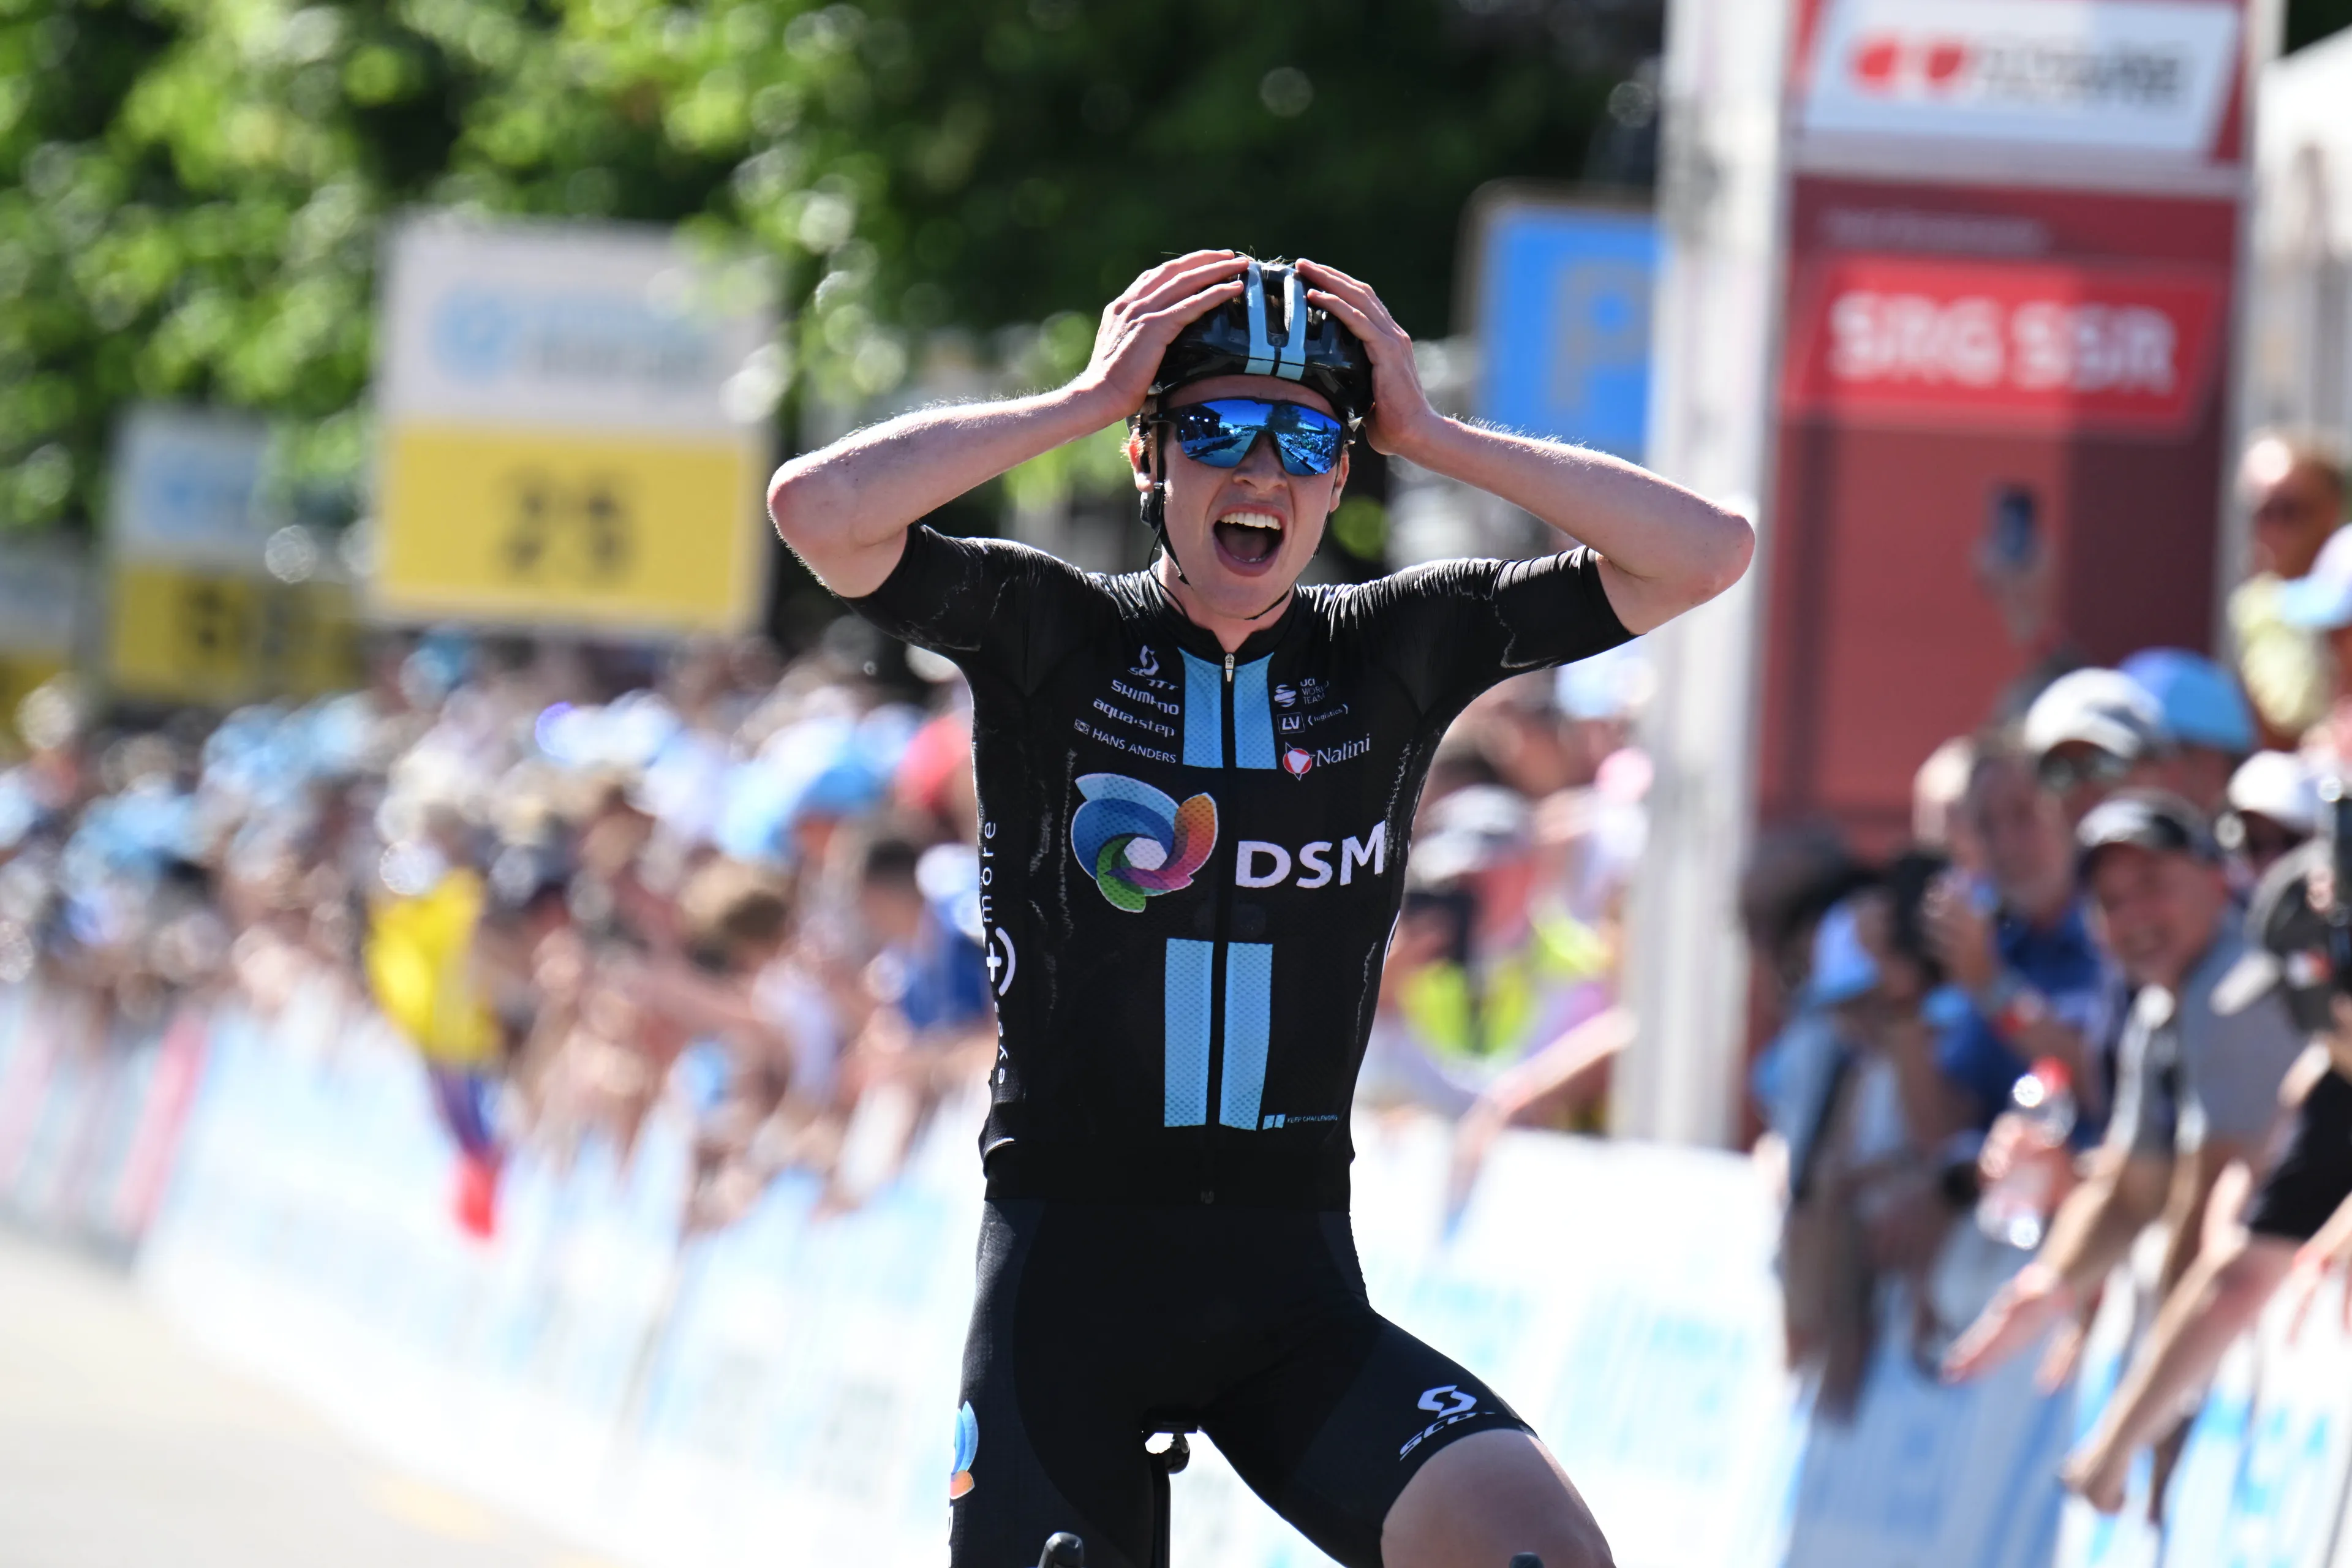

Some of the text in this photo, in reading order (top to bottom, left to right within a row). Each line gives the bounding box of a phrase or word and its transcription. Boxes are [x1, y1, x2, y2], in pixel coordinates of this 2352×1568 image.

[1830, 292, 2177, 395] SRG SSR
[1303, 693, 1325, 705] TEAM
[1092, 728, 1177, 763] HANS ANDERS
[1316, 733, 1370, 767] Nalini
[981, 821, 997, 923] more
[1235, 820, 1385, 889] DSM
